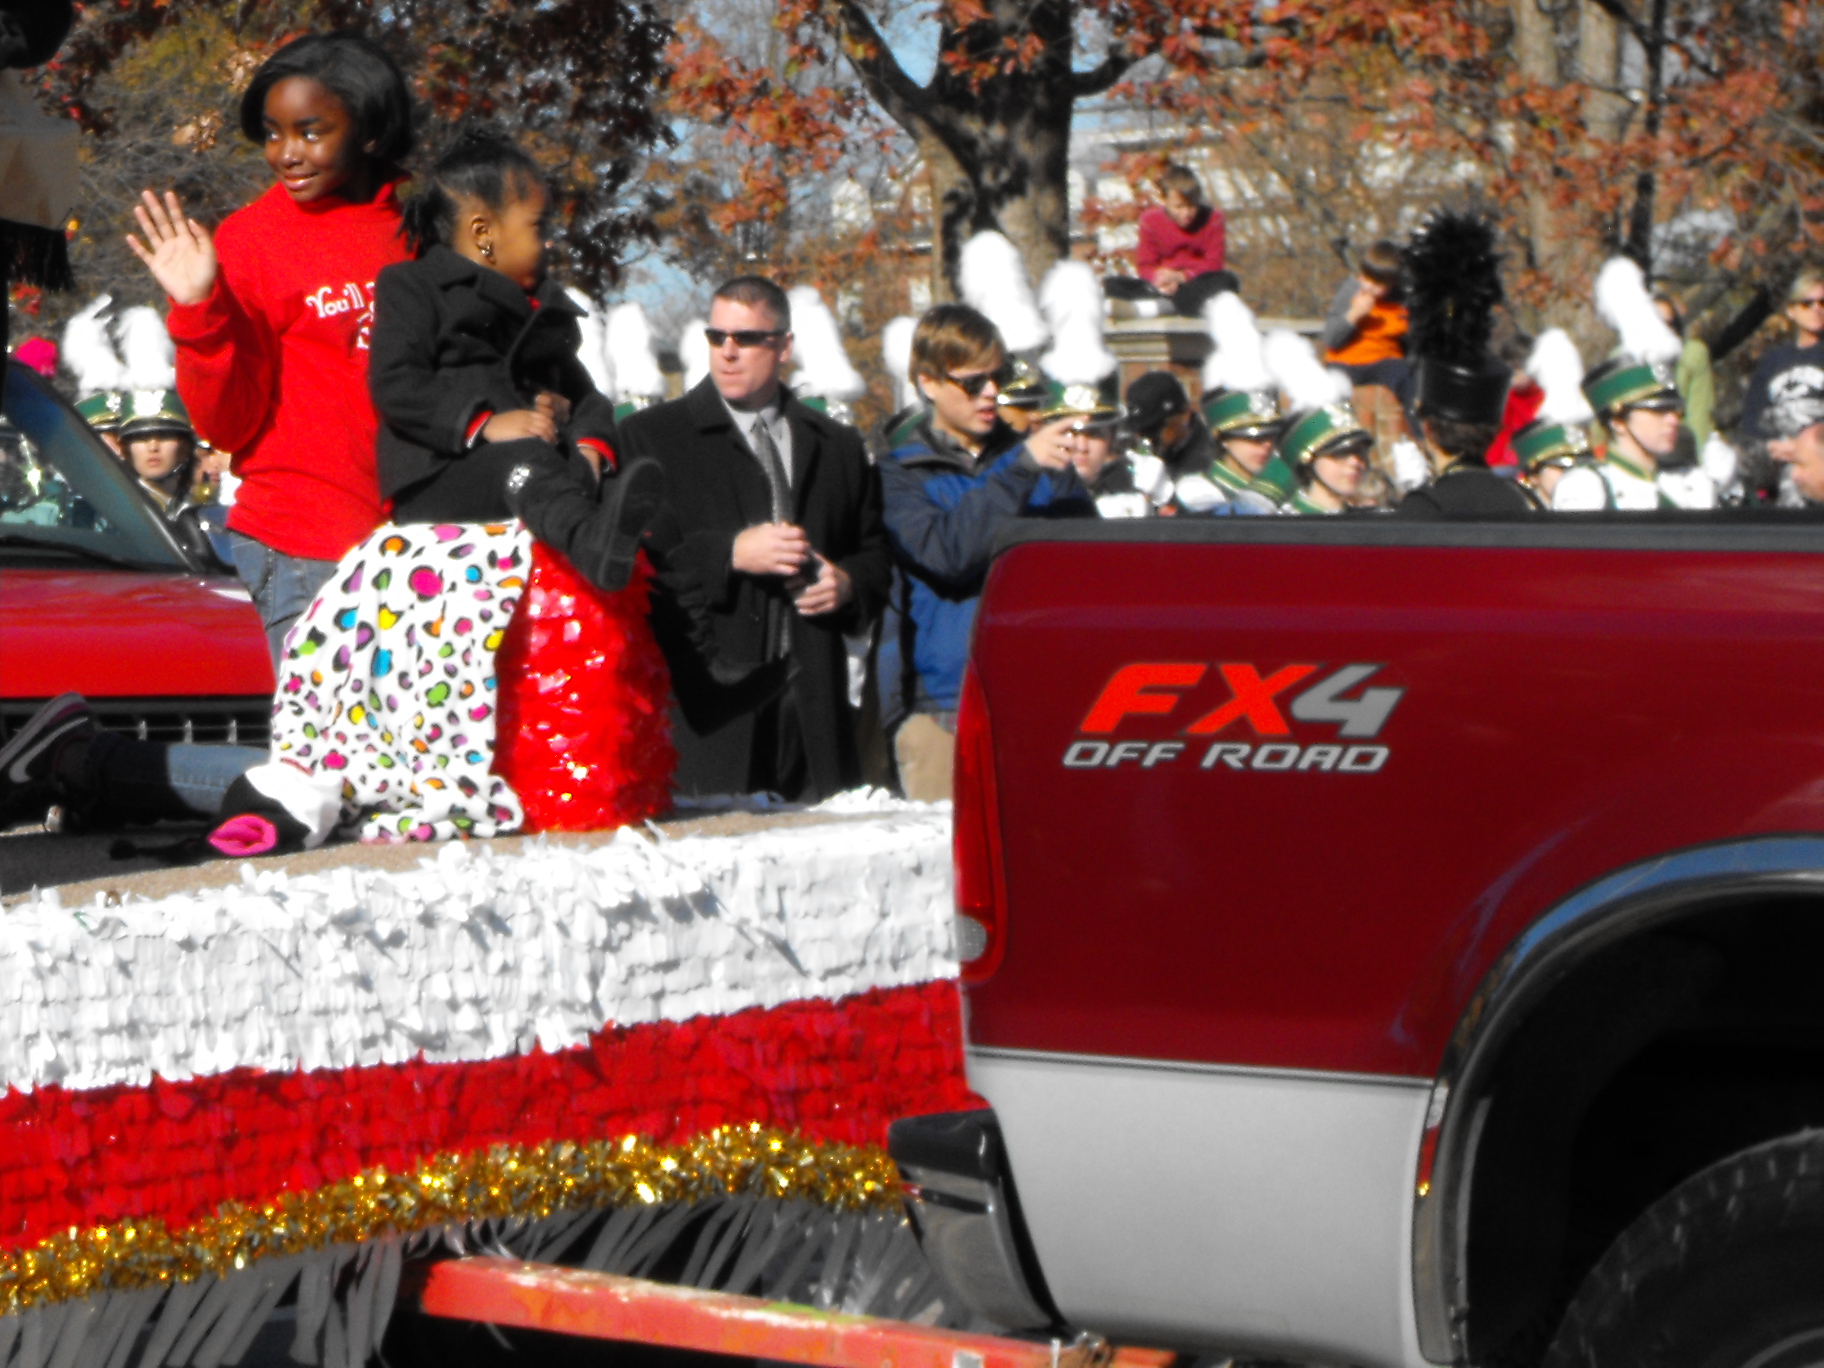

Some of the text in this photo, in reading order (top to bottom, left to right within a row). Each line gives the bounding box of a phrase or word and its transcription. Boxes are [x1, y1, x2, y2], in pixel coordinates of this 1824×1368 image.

[305, 283, 365, 318] You'll
[1078, 663, 1407, 738] FX4
[1062, 740, 1392, 774] OFF ROAD
